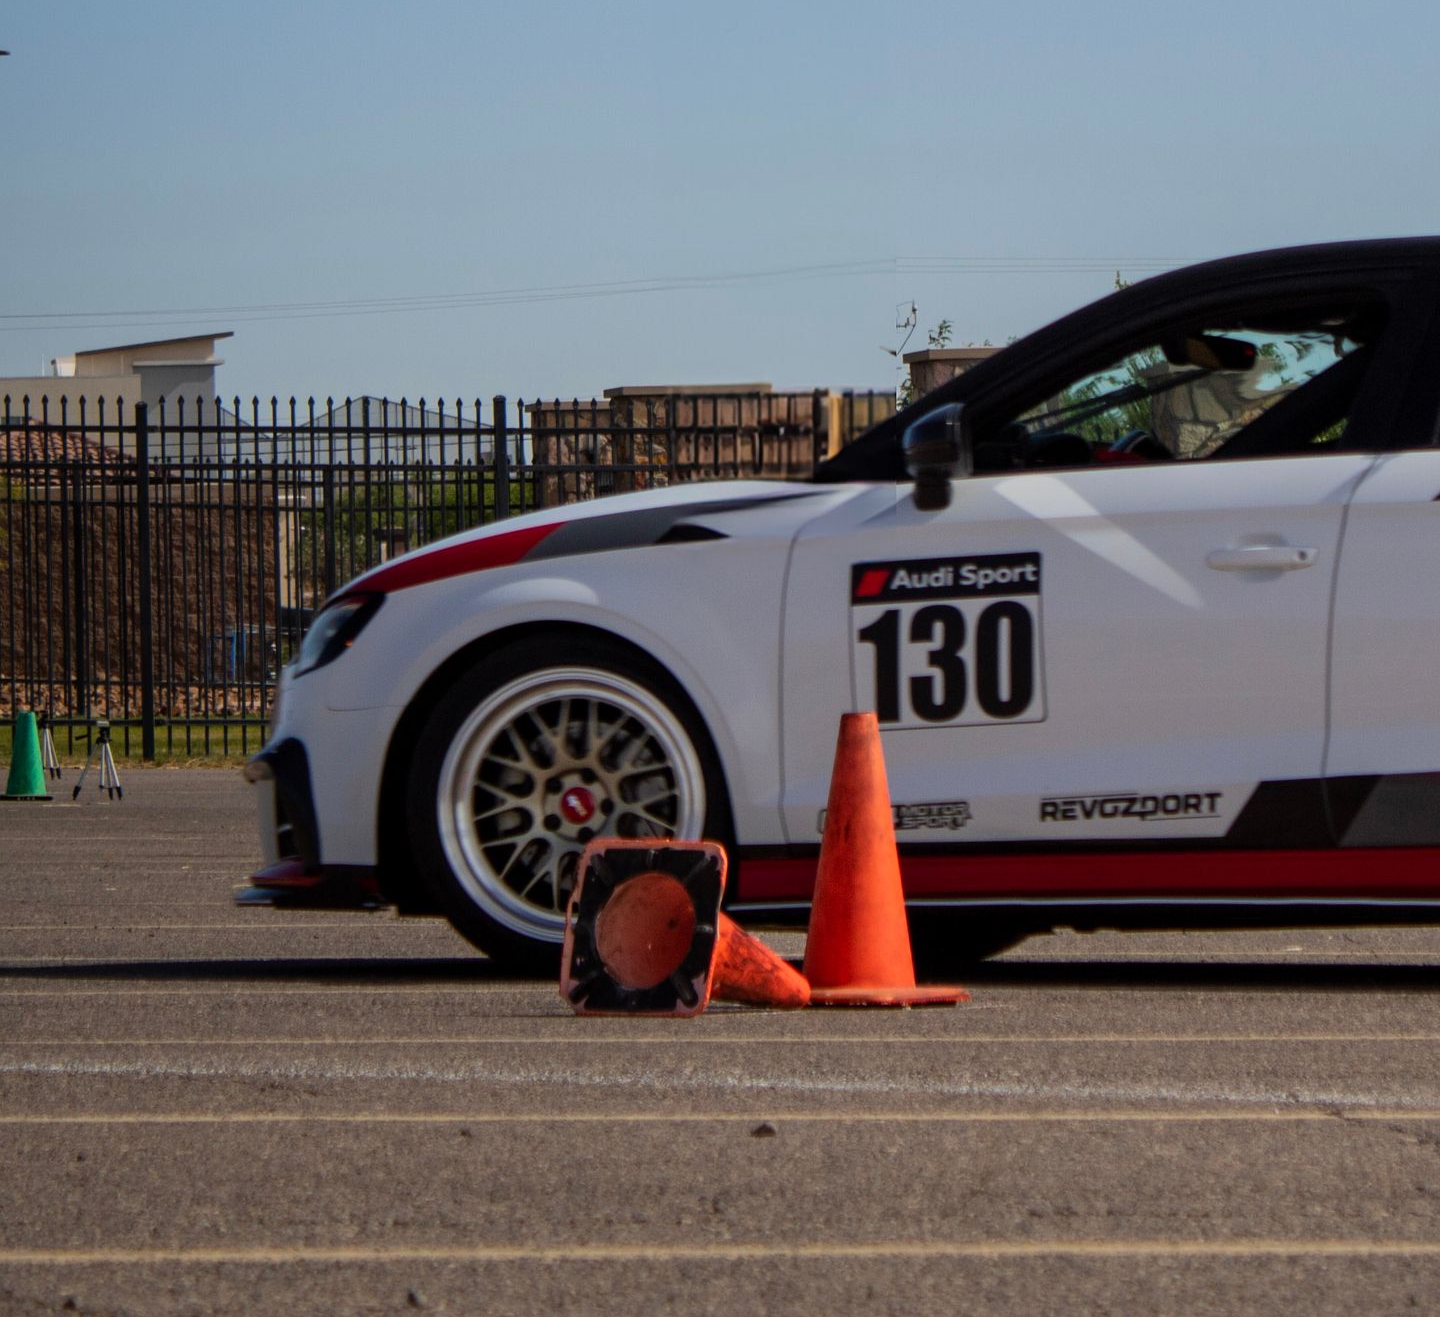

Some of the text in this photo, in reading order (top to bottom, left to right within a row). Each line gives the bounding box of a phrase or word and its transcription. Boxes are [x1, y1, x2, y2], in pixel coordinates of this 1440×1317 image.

[890, 562, 1038, 590] Audi Sport
[857, 600, 1035, 723] 130
